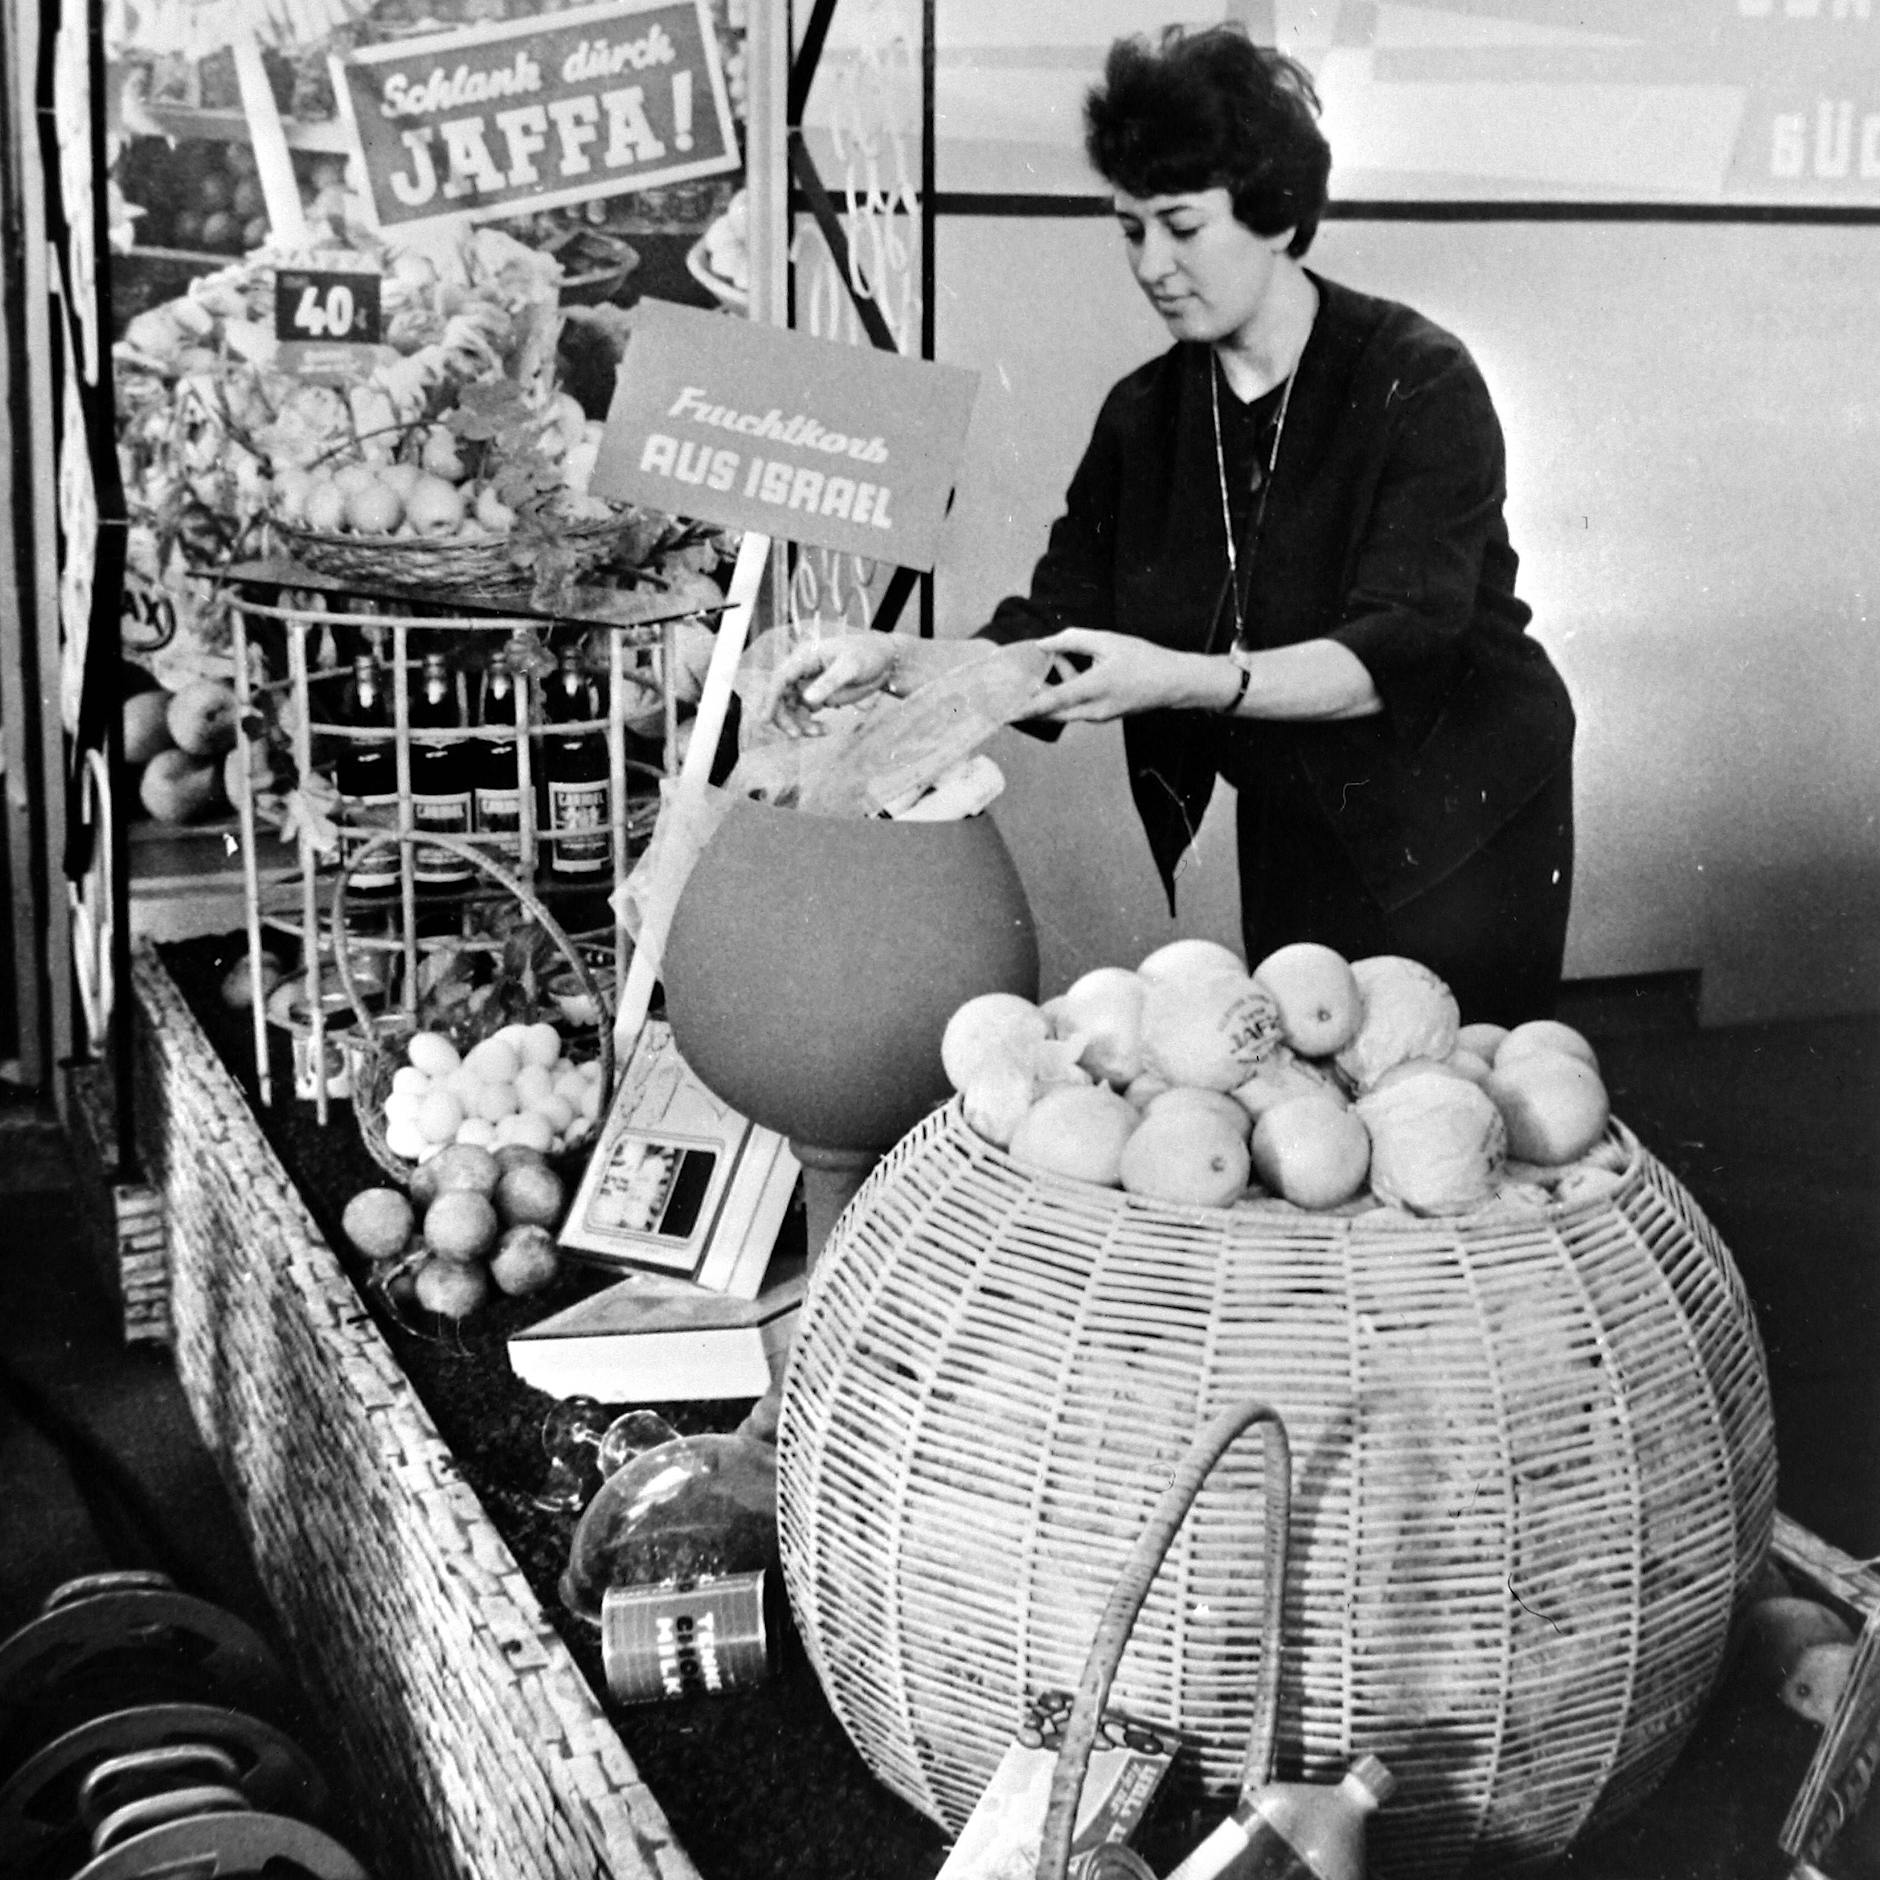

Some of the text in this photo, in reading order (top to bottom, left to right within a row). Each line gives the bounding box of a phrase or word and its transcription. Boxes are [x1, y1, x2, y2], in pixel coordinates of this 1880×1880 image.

[381, 51, 542, 118] Schlank
[390, 69, 694, 206] JAFFA!
[294, 285, 354, 337] 40
[667, 386, 890, 464] Fruchtkorb
[640, 434, 892, 529] AUS ISRAEL
[656, 1616, 682, 1695] MILK
